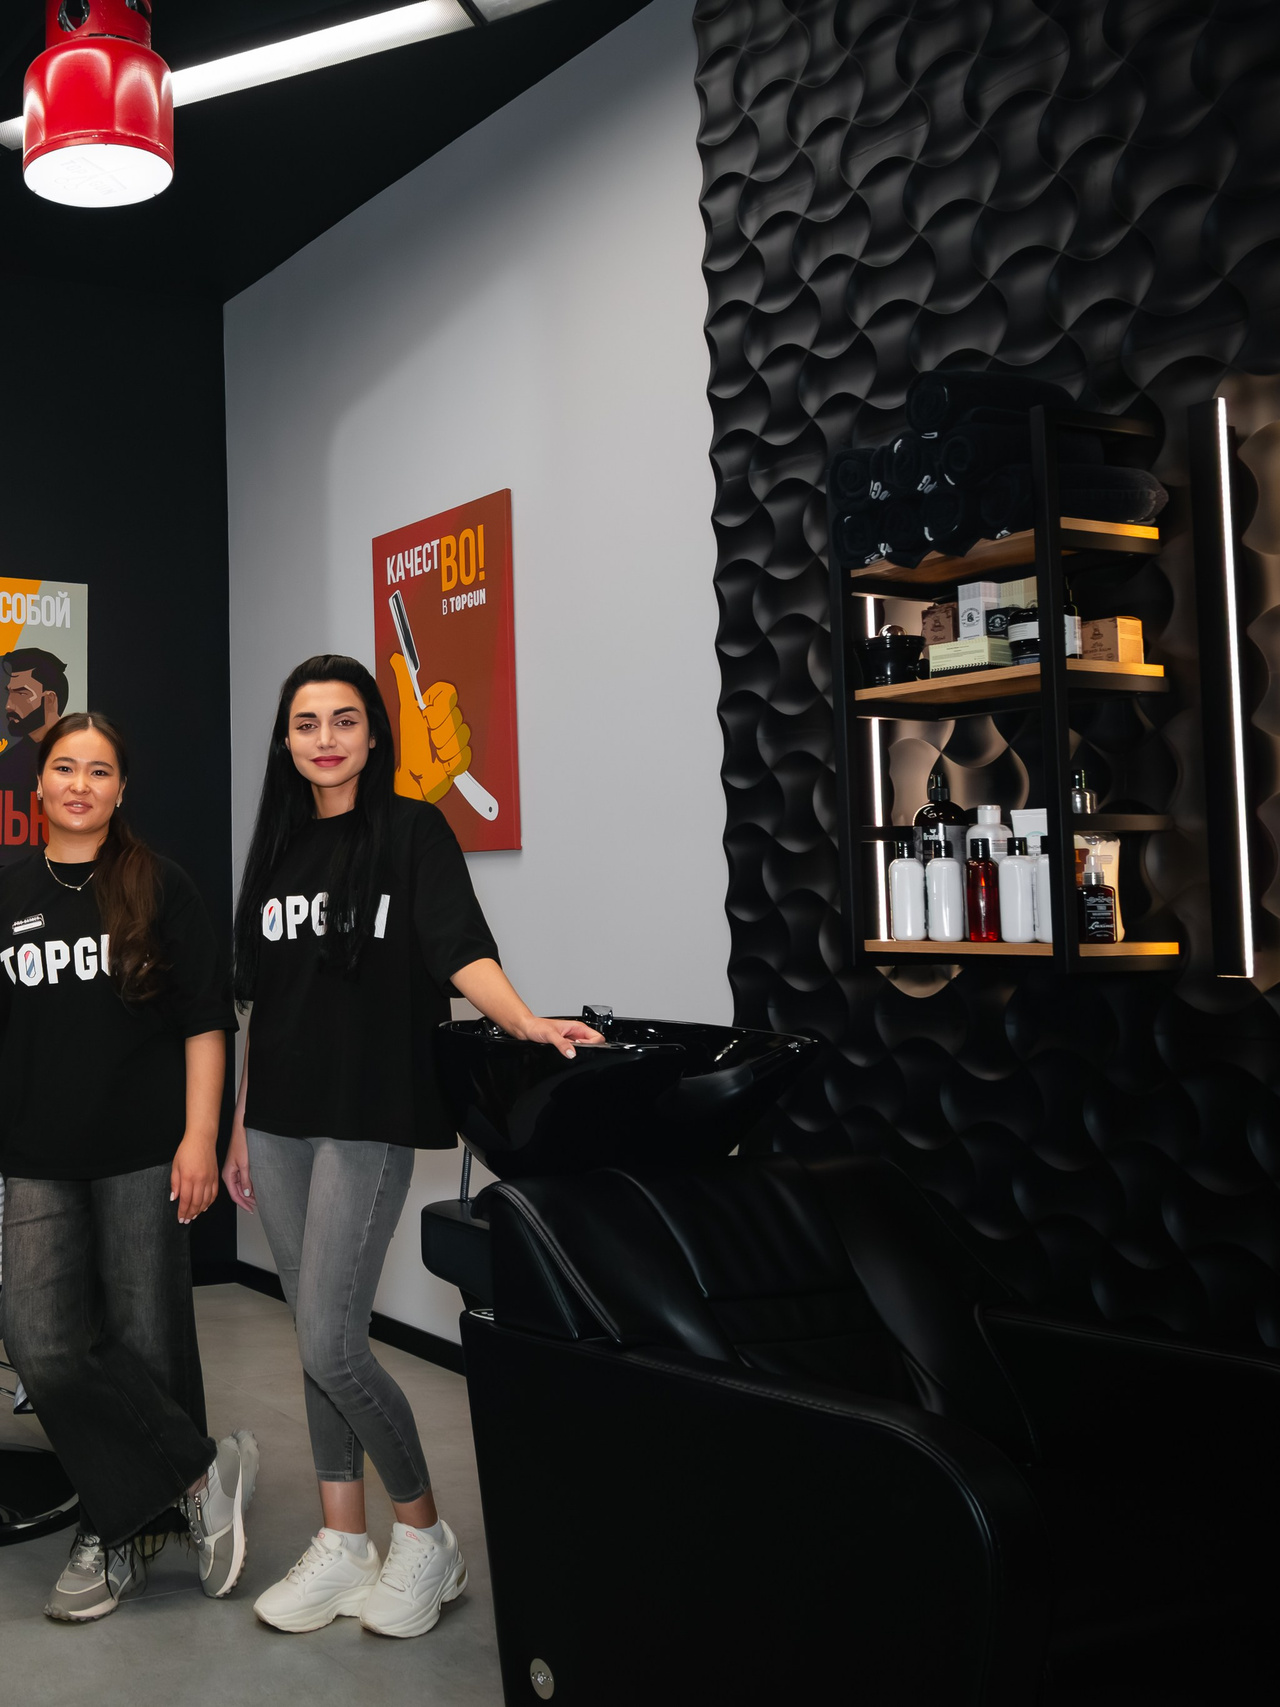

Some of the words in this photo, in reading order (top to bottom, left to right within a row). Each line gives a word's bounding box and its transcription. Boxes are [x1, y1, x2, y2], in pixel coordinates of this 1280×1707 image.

[442, 599, 448, 615] В
[450, 588, 486, 613] TOPGUN
[0, 934, 111, 987] TOPG
